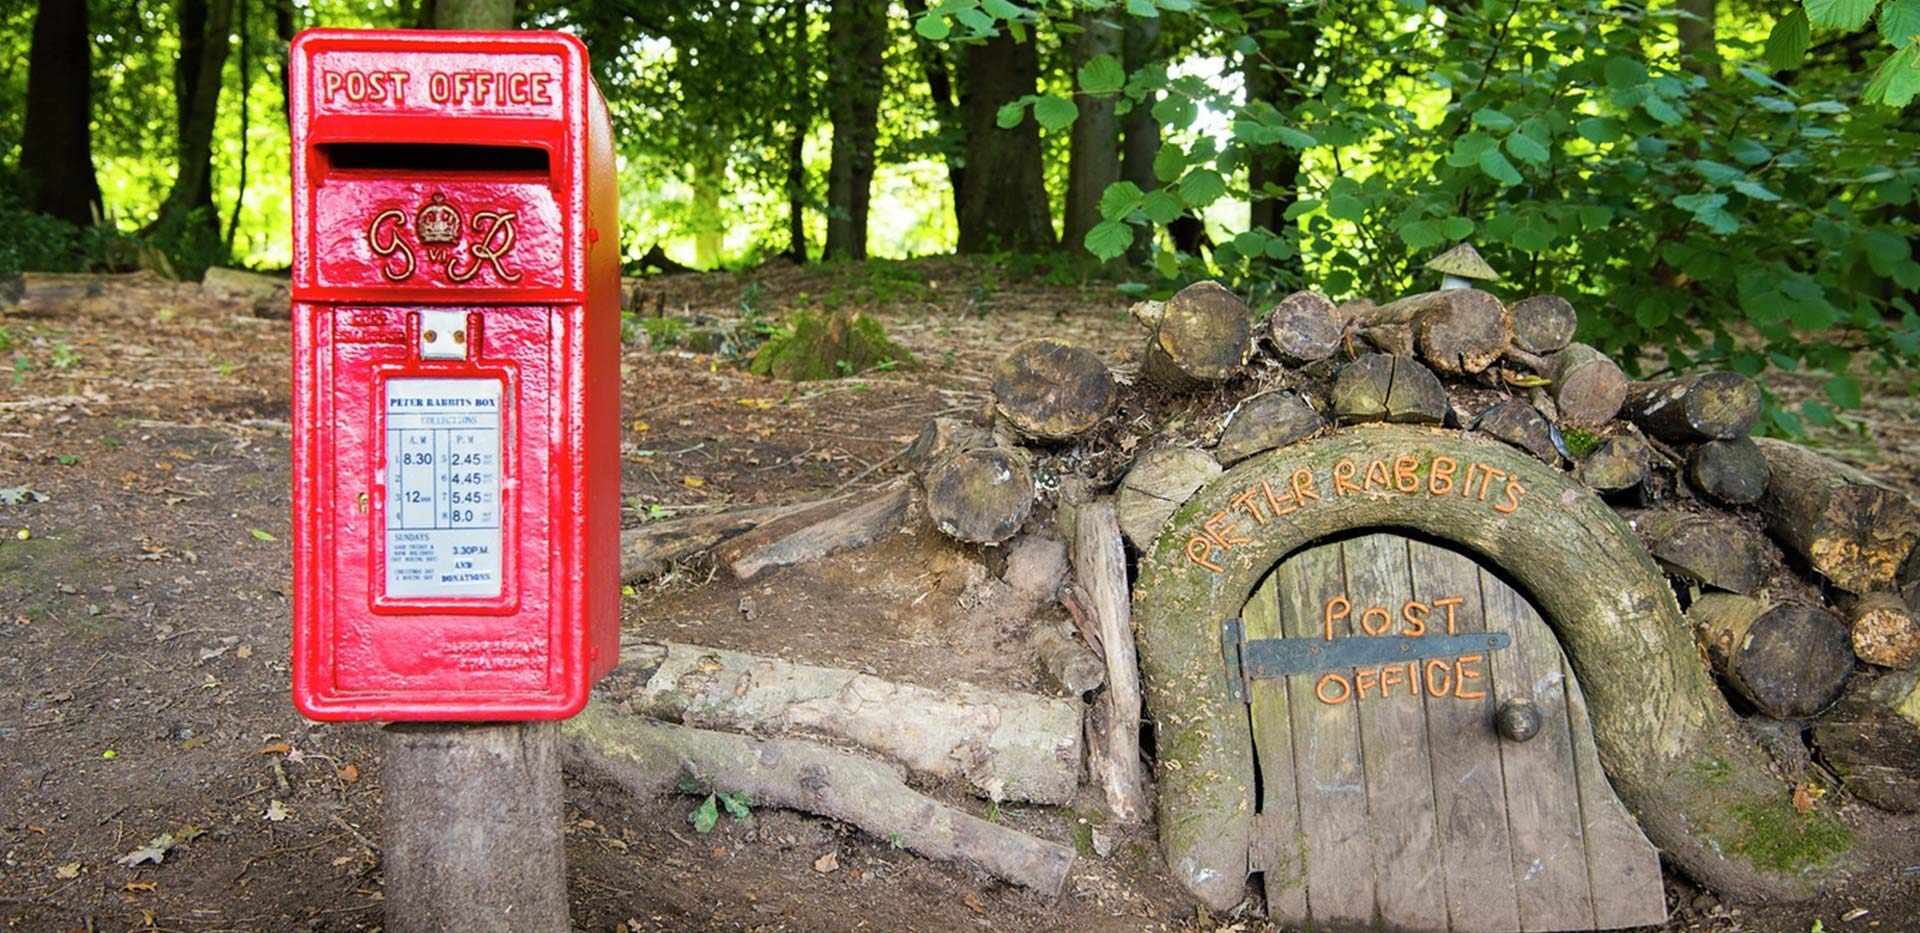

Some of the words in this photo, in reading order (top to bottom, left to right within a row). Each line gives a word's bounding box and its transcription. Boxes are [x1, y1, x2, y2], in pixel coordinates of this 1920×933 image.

[324, 71, 409, 102] POST
[429, 72, 552, 104] OFFICE
[390, 398, 424, 407] PETER
[426, 398, 472, 407] RABBITS
[475, 398, 496, 407] BOX
[403, 453, 432, 465] 8.30
[452, 453, 481, 466] 2.45
[452, 473, 481, 485] 4.45
[452, 492, 481, 504] 5.45
[452, 510, 473, 522] 8.0
[455, 561, 473, 569] AND
[441, 573, 491, 582] DONATIONS
[1325, 595, 1463, 641] POST
[1316, 655, 1486, 704] OFFICE
